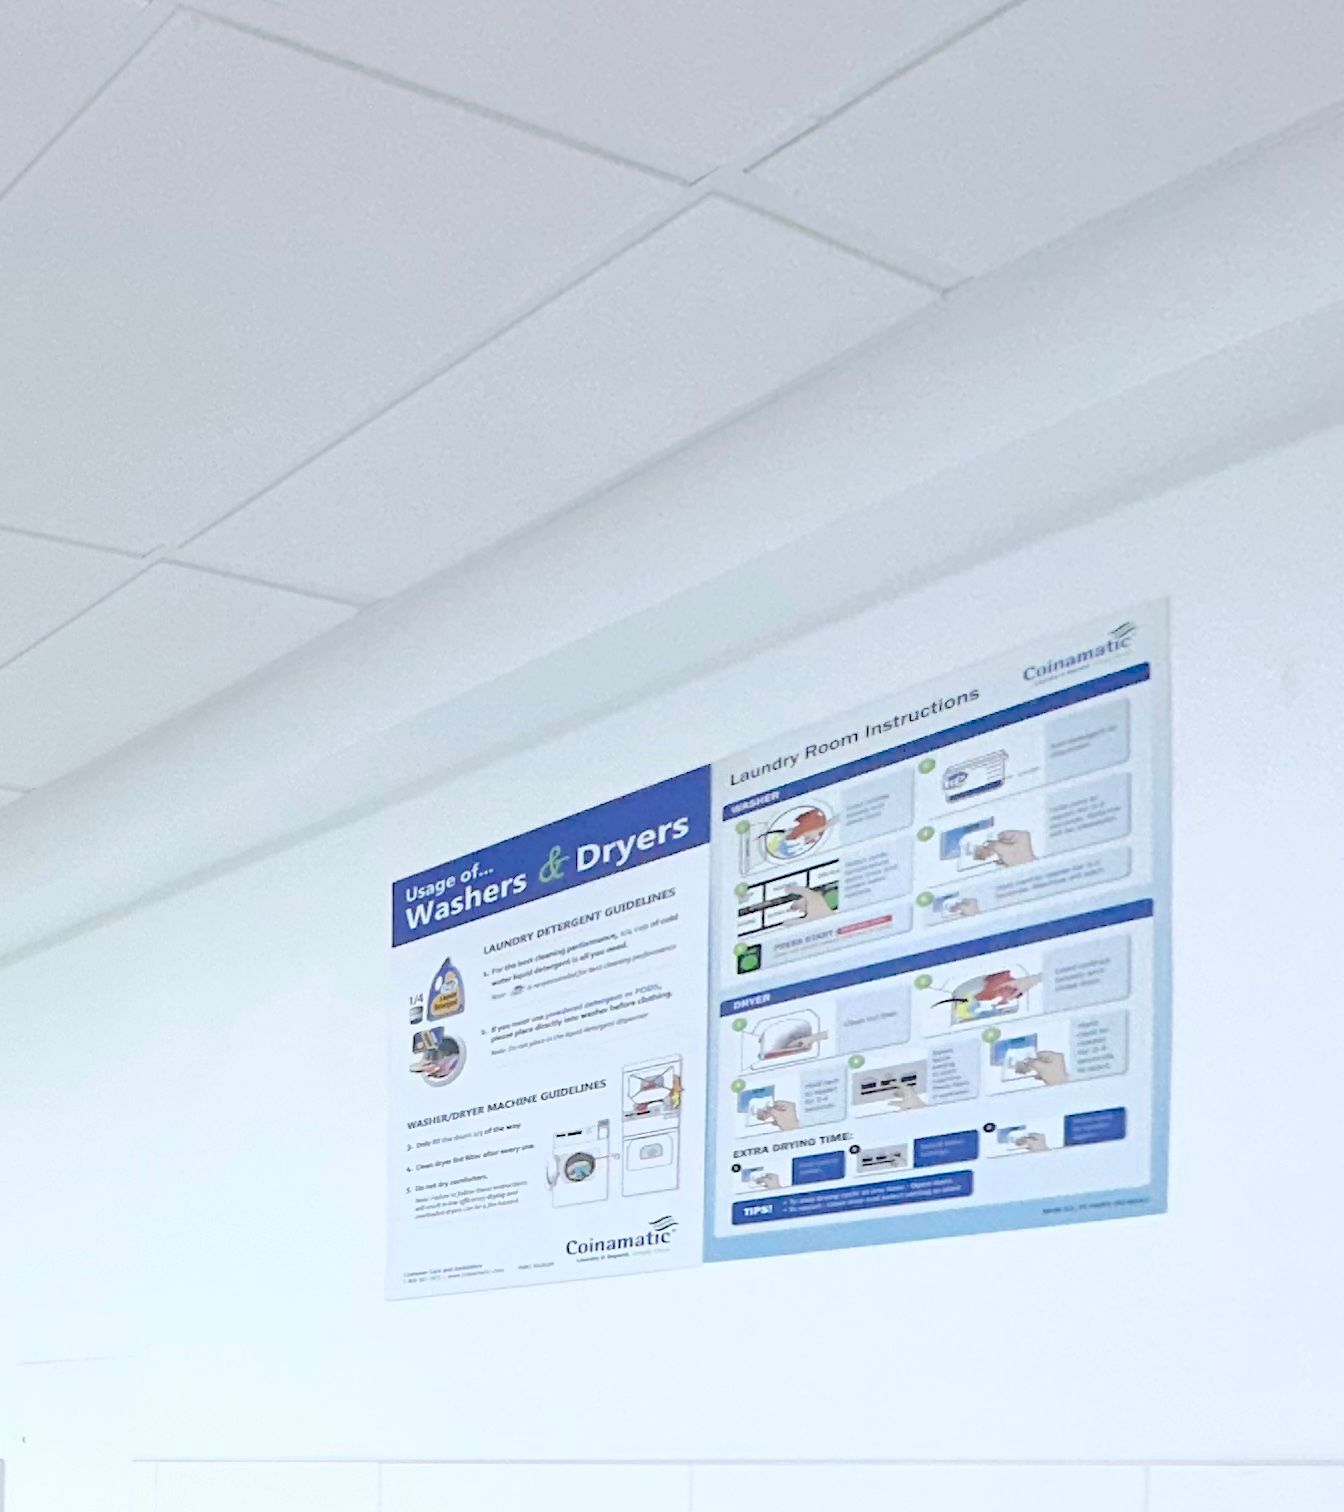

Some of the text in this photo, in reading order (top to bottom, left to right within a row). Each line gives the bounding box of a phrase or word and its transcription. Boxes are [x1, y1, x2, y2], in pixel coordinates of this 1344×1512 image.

[1023, 635, 1131, 682] Coinamatic
[730, 687, 981, 787] Laundry Room Instructions
[405, 816, 691, 930] Washers & Dryers
[405, 862, 494, 903] Usage of...
[483, 887, 677, 955] LAUNDRY DETERGENT GUIDELINES
[733, 993, 771, 1010] DRYER
[407, 1079, 607, 1130] WASHER/DRYER MACHINE GUIDELINES
[733, 1131, 855, 1159] EXTRA DRYING TIME:
[743, 1204, 773, 1216] TIPS!
[566, 1230, 671, 1257] Coinamatic
